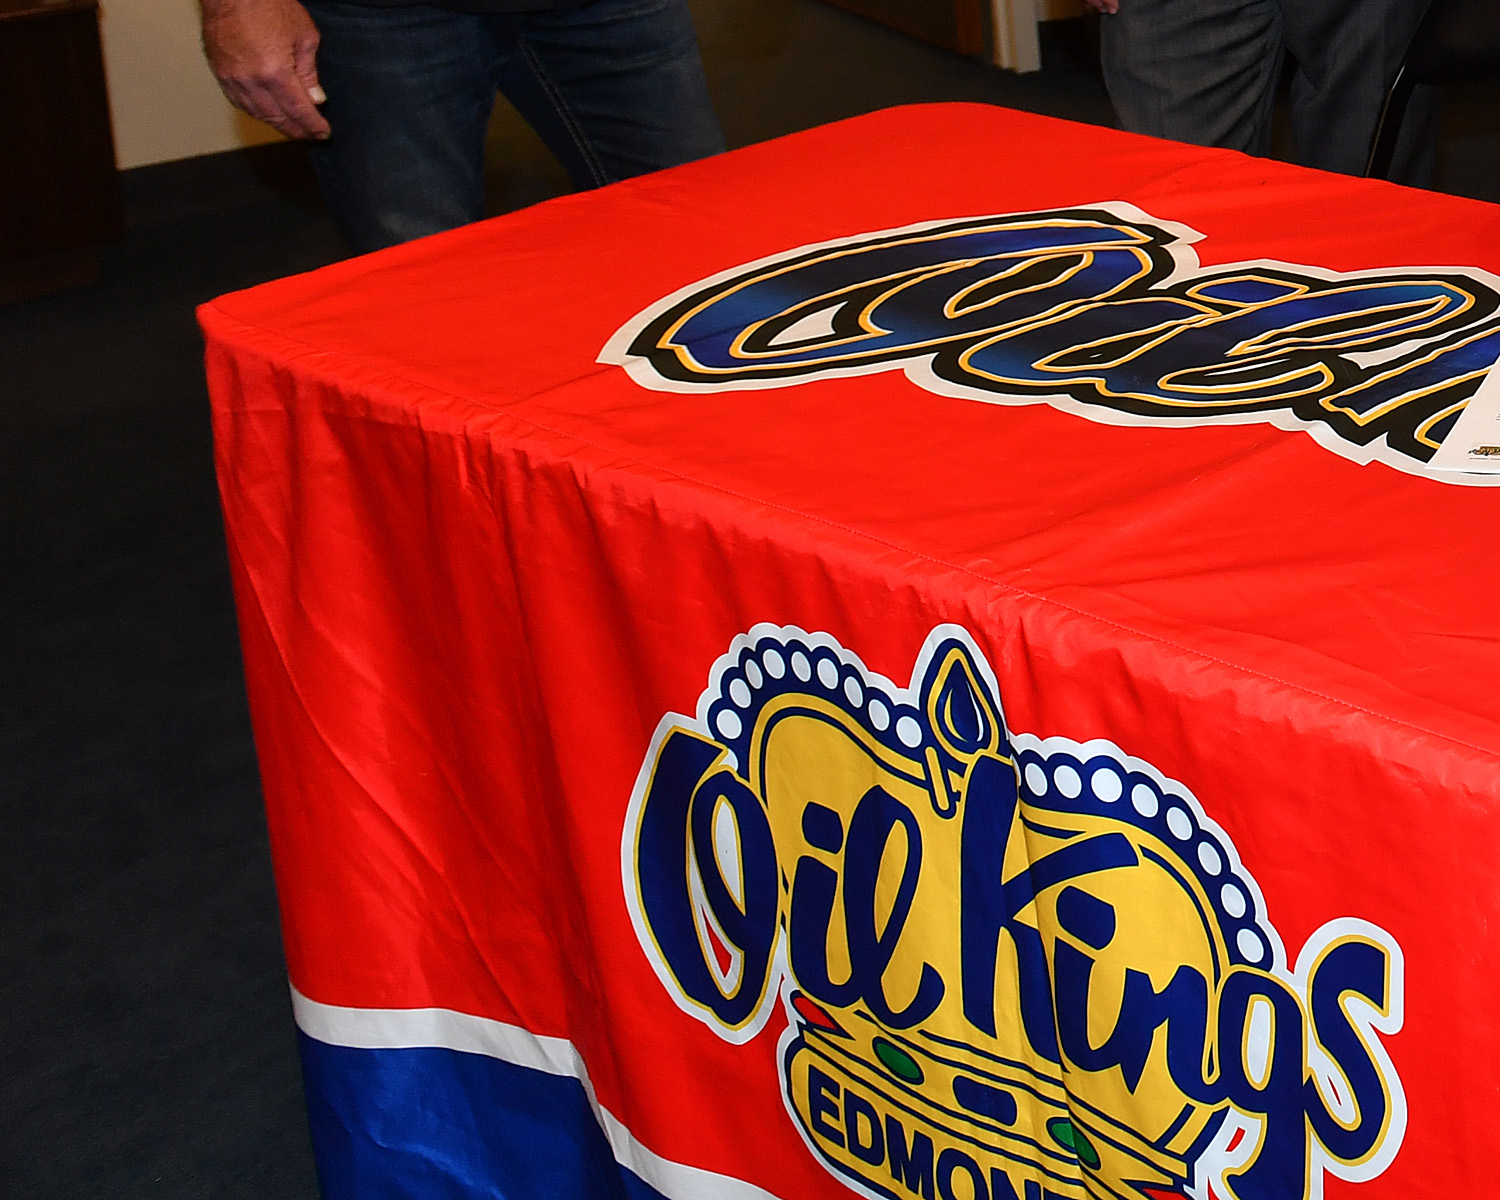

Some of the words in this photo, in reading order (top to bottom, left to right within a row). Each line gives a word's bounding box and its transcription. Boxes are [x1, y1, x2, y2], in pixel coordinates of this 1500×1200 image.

[625, 205, 1470, 440] Oil
[635, 725, 948, 1030] Oil
[958, 750, 1391, 1200] Kings
